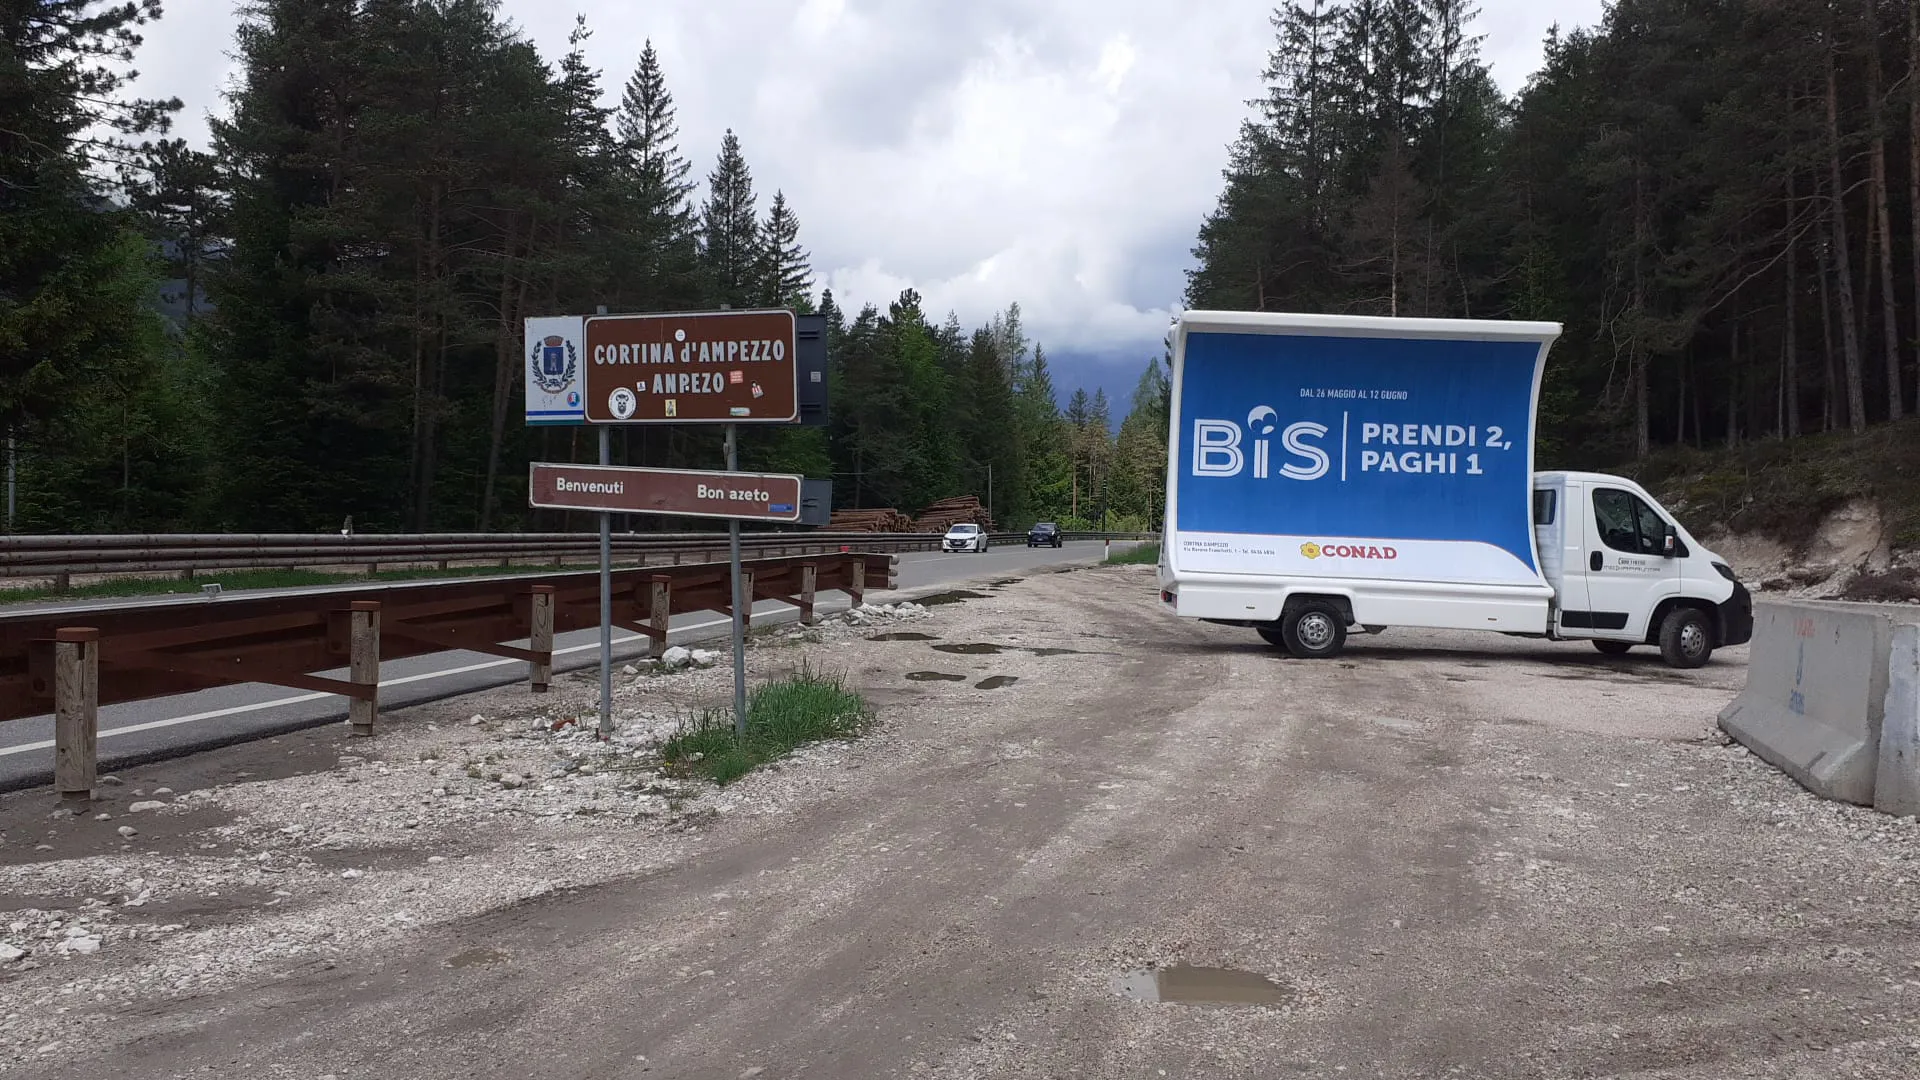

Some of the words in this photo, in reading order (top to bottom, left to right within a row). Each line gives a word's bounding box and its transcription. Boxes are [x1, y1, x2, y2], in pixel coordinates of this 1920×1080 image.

[594, 342, 675, 365] CORTINA
[680, 339, 785, 363] d'AMPEZZO
[652, 372, 725, 394] ANPEZO
[1300, 388, 1314, 398] DAL
[1316, 388, 1326, 398] 26
[1327, 389, 1357, 399] MAGGIO
[1358, 389, 1368, 399] AL
[1370, 390, 1379, 399] 12
[1362, 422, 1476, 447] PRENDI
[1485, 425, 1513, 451] 2,
[1361, 450, 1457, 474] PAGHI
[1466, 453, 1483, 475] 1
[556, 477, 624, 494] Benvenuti
[697, 484, 724, 499] Bon
[729, 488, 769, 502] azeto
[1321, 544, 1398, 560] CONAD
